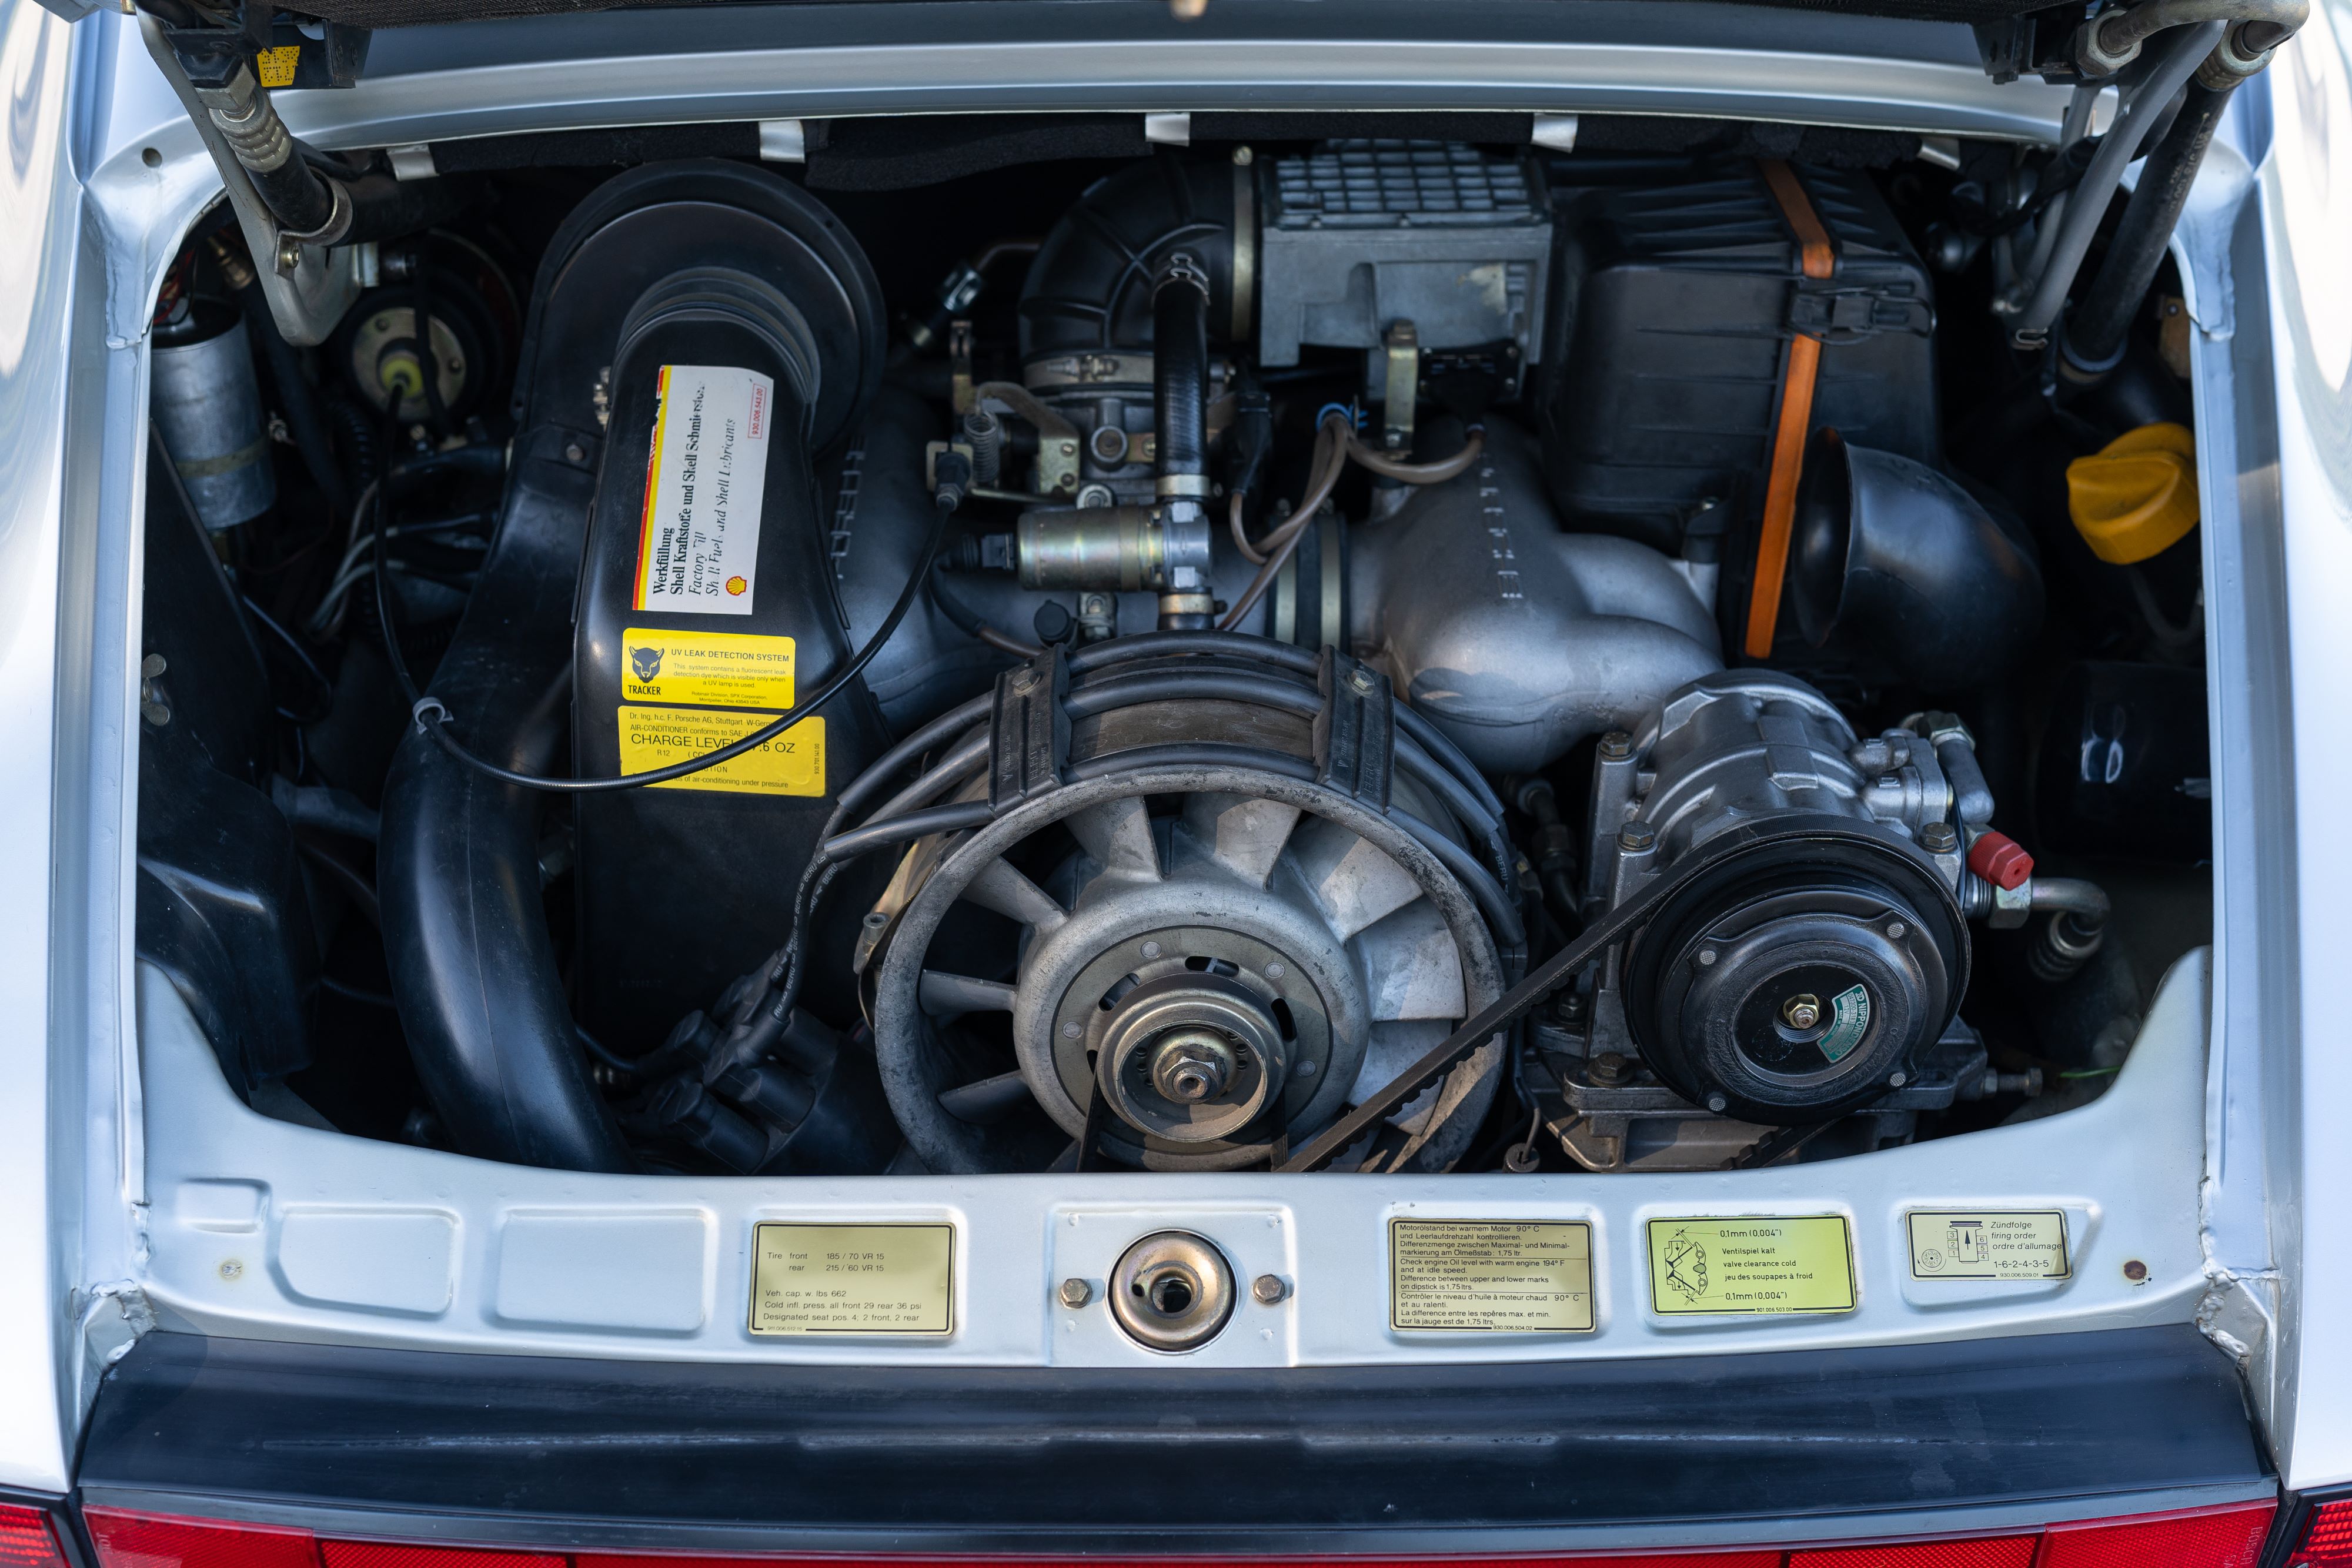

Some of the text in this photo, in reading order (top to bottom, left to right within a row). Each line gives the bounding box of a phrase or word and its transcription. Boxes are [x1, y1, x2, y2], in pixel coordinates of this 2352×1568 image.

[683, 454, 698, 482] Shell
[682, 485, 694, 506] und
[653, 528, 674, 594] Werkfüllung
[689, 553, 707, 595] Factory
[670, 566, 685, 595] Shell
[706, 566, 720, 596] Shll
[708, 650, 754, 660] DETECTION
[756, 653, 789, 661] SYSTEM
[627, 684, 661, 695] TRACKER
[675, 714, 700, 723] Porsche
[715, 717, 743, 726] Stuttgart
[630, 724, 688, 733] AIR-CONDITIONER
[631, 733, 692, 747] CHARGE
[775, 742, 796, 754] OZ
[692, 776, 740, 786] air-conditioning
[803, 863, 817, 883] BERU
[822, 863, 838, 885] BERU
[1835, 1002, 1867, 1056] NIPPONDENSO
[1990, 1221, 2032, 1229] Zündfolge
[1991, 1232, 2012, 1241] firing
[1400, 1241, 1455, 1249] Differenzmenge
[2017, 1242, 2062, 1251] d'allumage
[1400, 1249, 1439, 1257] markierung
[1993, 1259, 2049, 1268] 1-6-2-4-3-5
[763, 1313, 808, 1321] Designated
[2240, 1527, 2263, 1564] BOSCH
